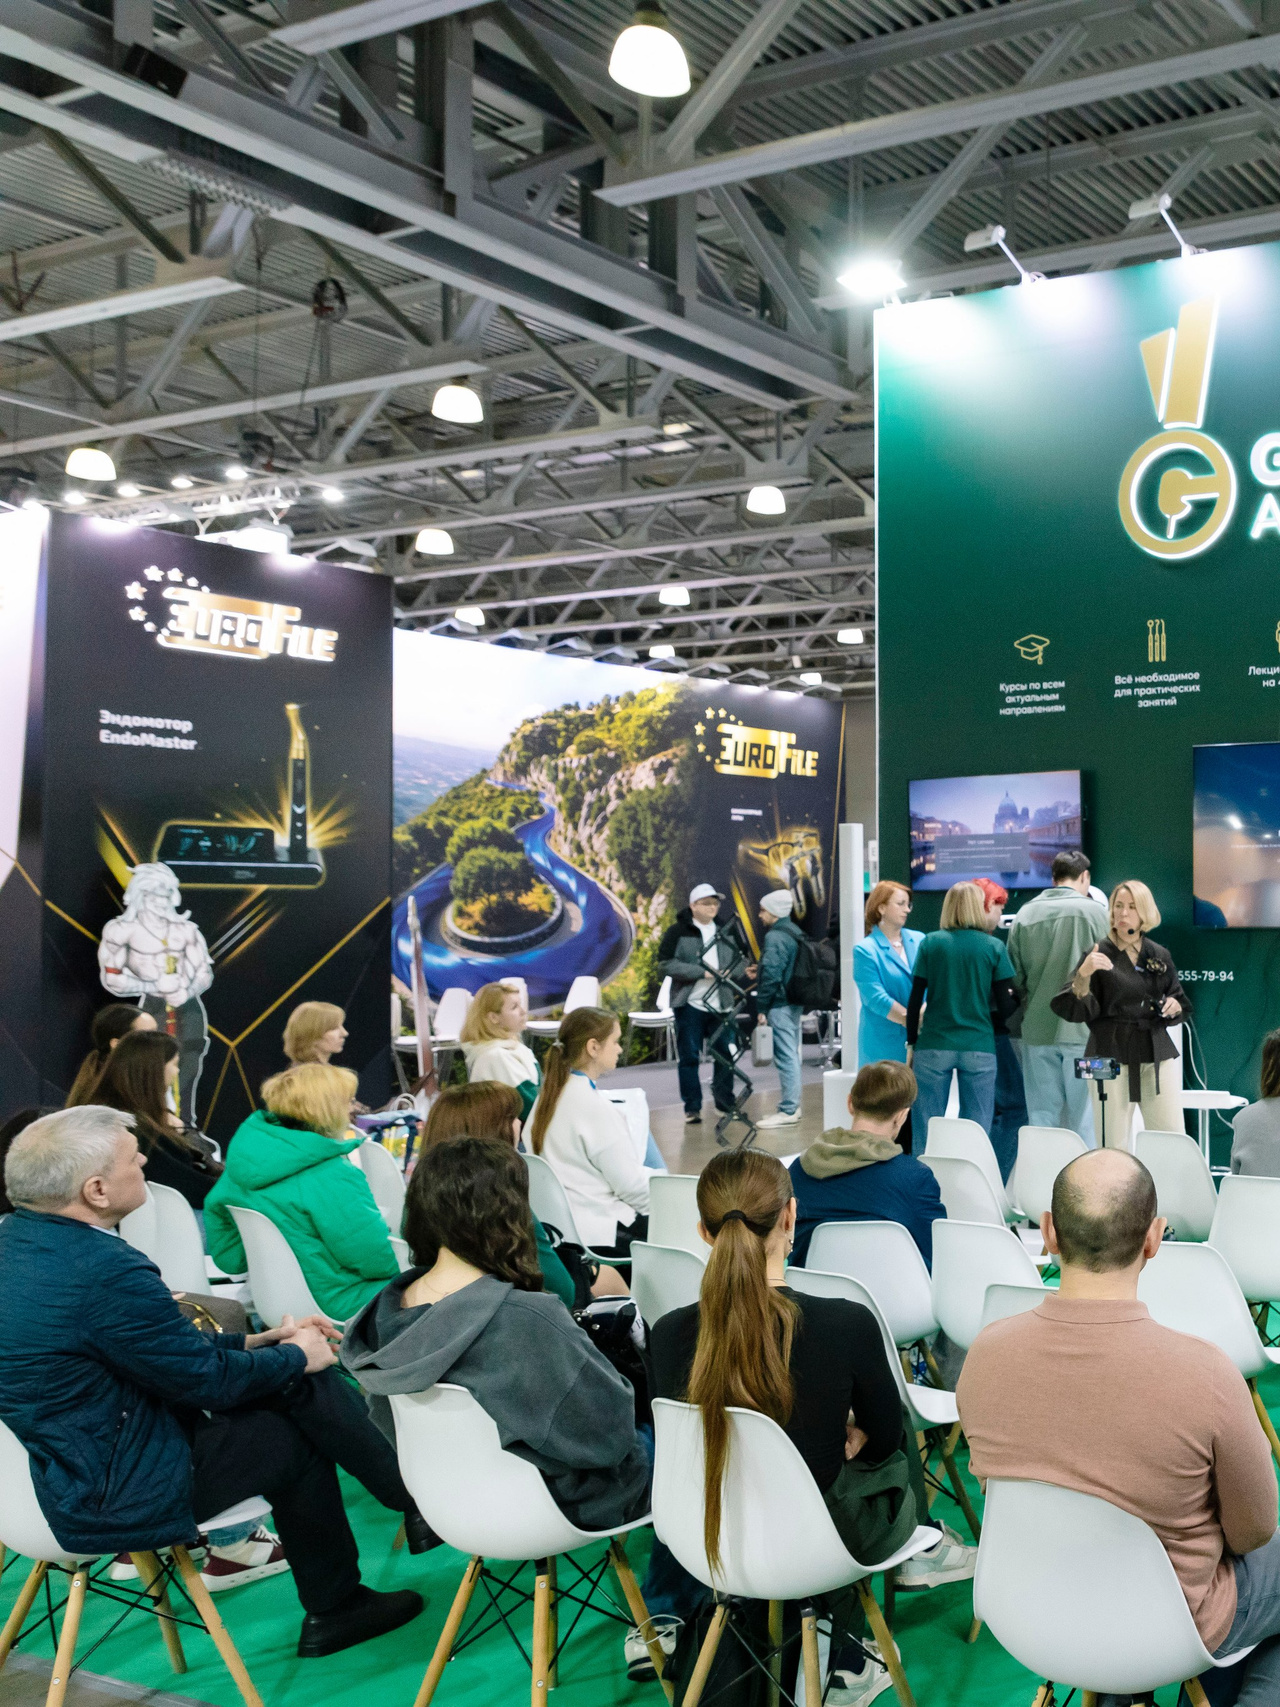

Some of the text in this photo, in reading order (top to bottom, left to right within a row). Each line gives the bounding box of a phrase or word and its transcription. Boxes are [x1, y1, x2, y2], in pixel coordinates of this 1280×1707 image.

[1114, 671, 1200, 685] Всё необходимое
[1262, 676, 1275, 688] на
[999, 680, 1066, 694] Курсы по всем
[1114, 683, 1200, 698] для практических
[1005, 692, 1059, 704] актуальным
[1137, 696, 1177, 709] занятий
[999, 704, 1066, 717] направлениям
[99, 709, 193, 733] Эндомотор
[99, 730, 198, 750] EndoMaster
